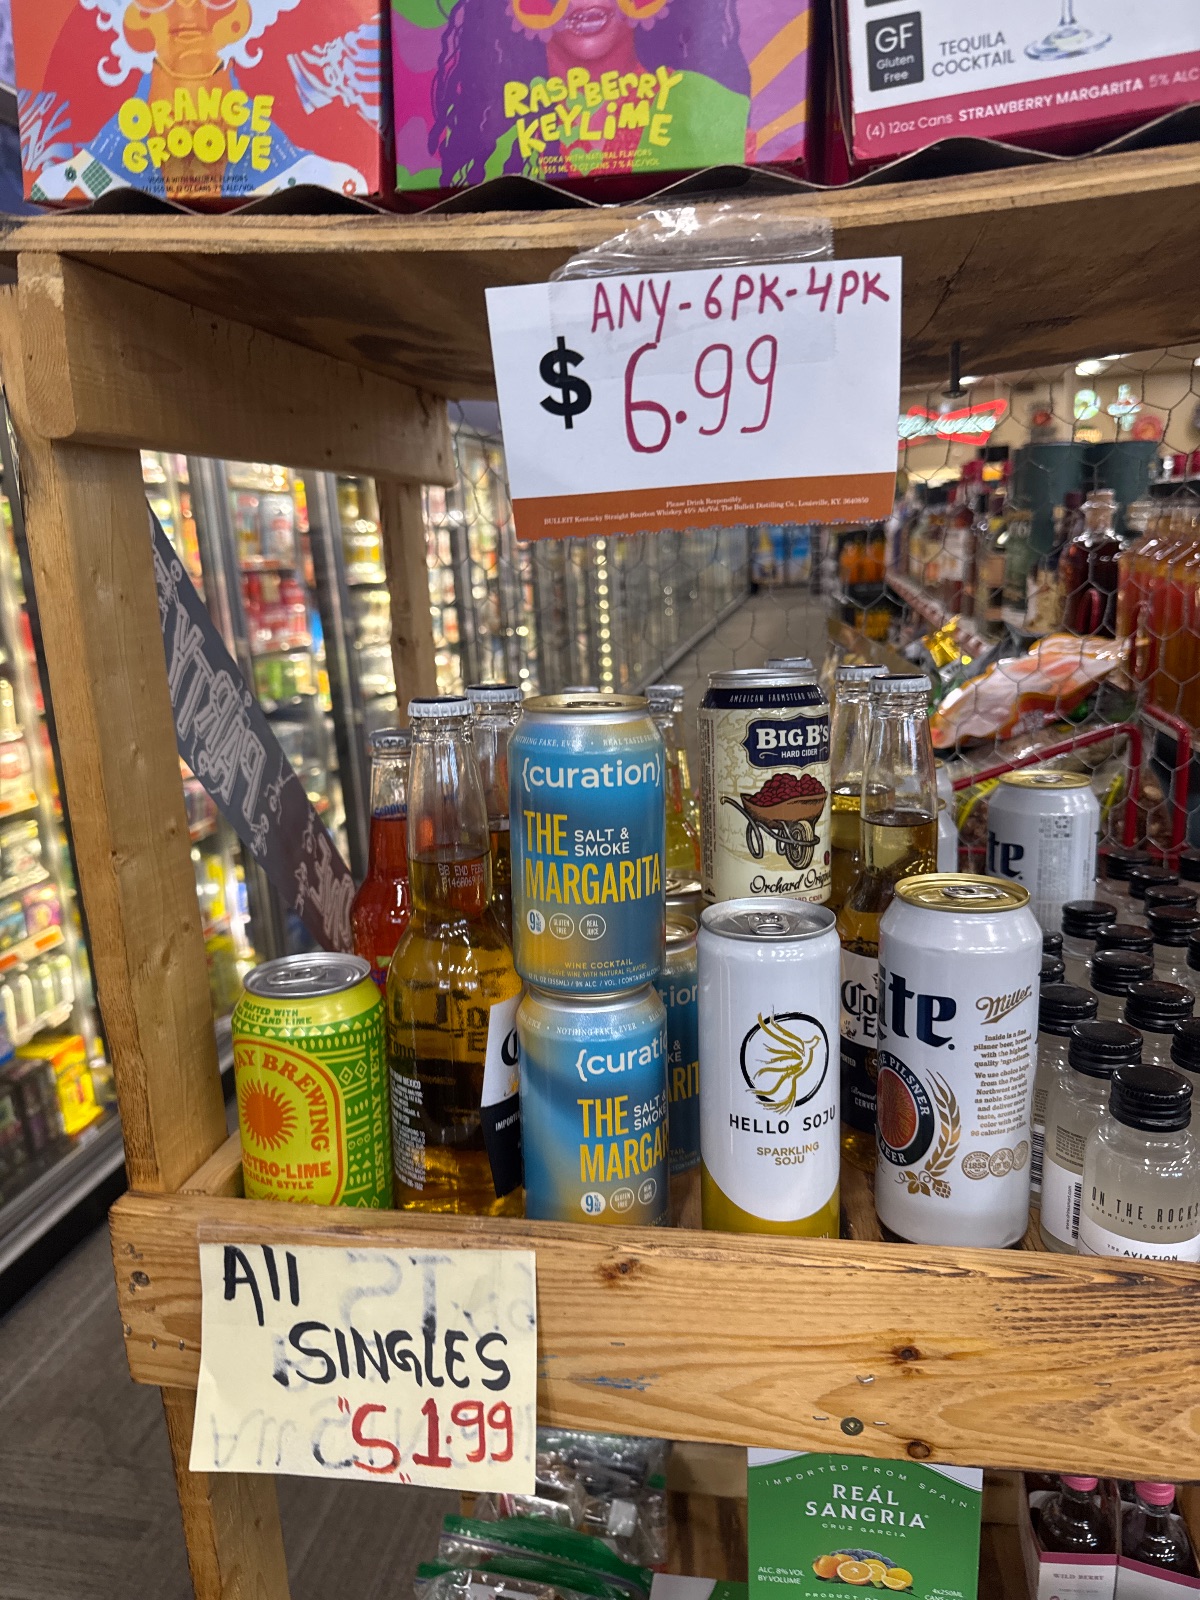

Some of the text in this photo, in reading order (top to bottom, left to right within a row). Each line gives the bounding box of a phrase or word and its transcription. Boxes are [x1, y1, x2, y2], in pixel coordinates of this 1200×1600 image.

[875, 22, 914, 53] GF
[939, 30, 1006, 57] TEQUILA
[876, 54, 915, 70] Gluten
[932, 49, 1015, 78] COCKTAIL
[883, 71, 909, 83] Free
[118, 87, 275, 141] ORANGE
[866, 123, 885, 140] (4)
[888, 119, 915, 136] 12oz
[917, 112, 953, 130] Cans
[958, 95, 1053, 123] STRAWBERRY
[1055, 77, 1143, 106] MARGARITA
[123, 124, 273, 173] GROOVE
[666, 500, 685, 508] Please
[687, 498, 704, 506] Drink
[575, 514, 603, 524] Kentucky
[604, 513, 629, 522] Straight
[630, 511, 656, 519] Bourbon
[756, 501, 785, 510] Distilling
[729, 694, 764, 703] AMERICAN
[756, 728, 804, 750] BIG
[781, 748, 818, 759] HARD CIDER
[524, 809, 568, 857] THE
[574, 827, 630, 843] SALT &
[575, 841, 630, 857] SMOKE
[525, 853, 661, 906] MARGARITA
[750, 873, 805, 894] Orchard
[586, 919, 599, 928] REAL
[586, 928, 599, 936] JUICE
[564, 958, 633, 969] WINE COCKTAIL
[599, 969, 625, 977] NATURAL
[975, 984, 1032, 1021] Miller
[262, 1016, 281, 1025] AND
[286, 1016, 313, 1025] LIME
[274, 1008, 299, 1017] WITH
[984, 1033, 1005, 1042] Inside
[973, 1043, 998, 1052] pilsner
[1009, 1044, 1028, 1056] highest
[974, 1059, 999, 1069] quality
[1000, 1067, 1019, 1077] choice
[889, 1055, 930, 1116] PILSNER
[998, 1078, 1009, 1086] the
[976, 1086, 1010, 1095] Northwest
[262, 1053, 331, 1152] BREWING
[633, 1094, 660, 1118] SALT
[984, 1095, 1002, 1104] noble
[991, 1102, 1013, 1111] deliver
[371, 1093, 383, 1138] DAY
[577, 1095, 629, 1138] THE
[633, 1101, 667, 1131] SMOKE
[729, 1104, 837, 1135] HELLO SOJU
[980, 1121, 998, 1129] color
[980, 1127, 1006, 1137] calories
[756, 1142, 820, 1157] SPARKLING
[373, 1141, 385, 1194] BEST
[774, 1155, 806, 1166] SOJU
[276, 1180, 314, 1190] STYLE
[1092, 1186, 1199, 1223] ON THE ROCKS
[765, 1464, 969, 1510] IMPORTED FROM SPAIN
[832, 1484, 900, 1507] REÁL
[805, 1501, 927, 1530] SANGRIA
[821, 1522, 907, 1539] CRUZ GARCIA
[757, 1574, 801, 1585] BY VOLUME
[758, 1566, 806, 1577] ALC. 8% VOL
